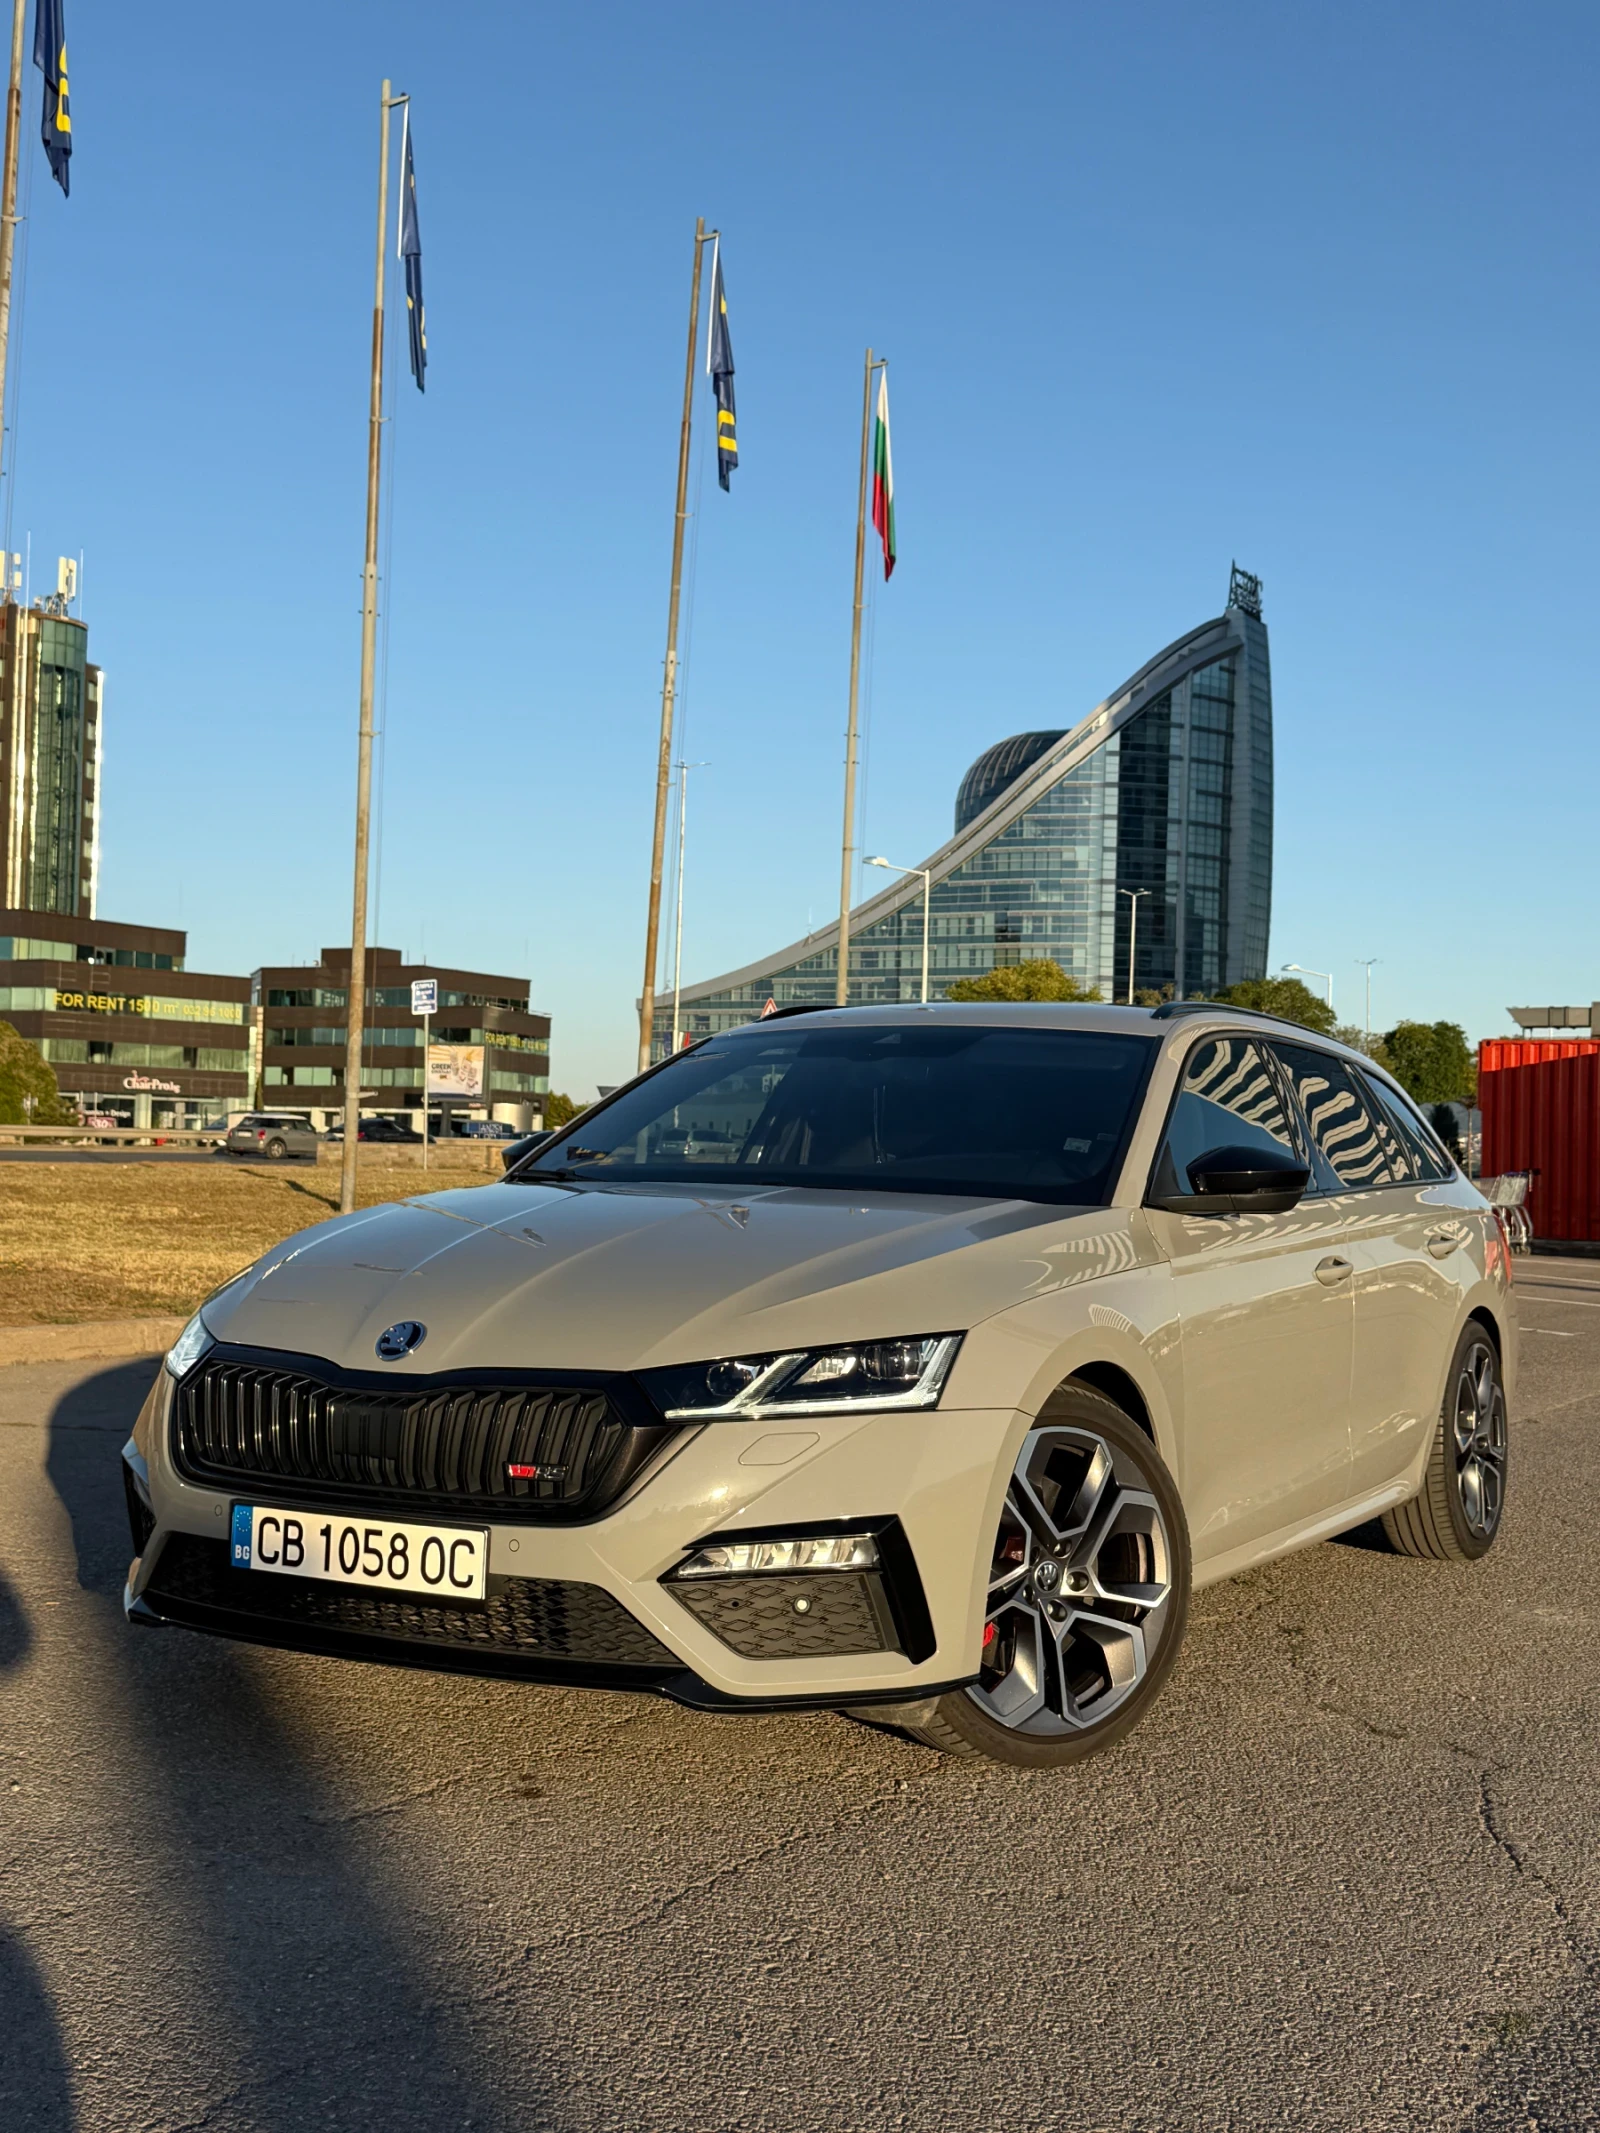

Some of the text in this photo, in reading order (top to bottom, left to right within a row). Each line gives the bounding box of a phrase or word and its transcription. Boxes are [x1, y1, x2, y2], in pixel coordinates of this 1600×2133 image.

[53, 992, 84, 1007] FOR
[87, 995, 127, 1011] RENT
[128, 998, 160, 1013] 1500
[234, 1545, 250, 1560] BG
[257, 1516, 476, 1589] CB 1058 OC
